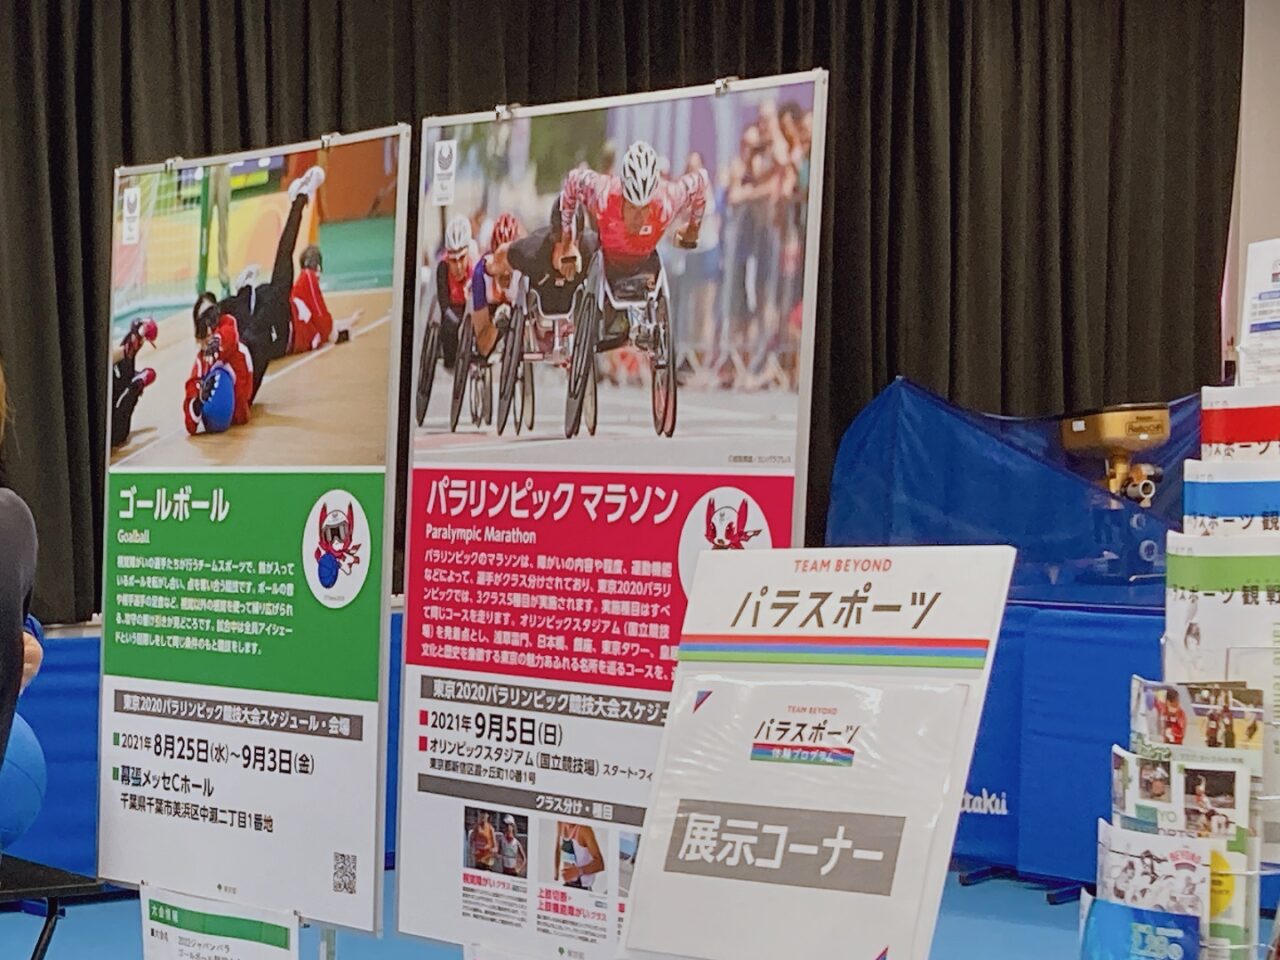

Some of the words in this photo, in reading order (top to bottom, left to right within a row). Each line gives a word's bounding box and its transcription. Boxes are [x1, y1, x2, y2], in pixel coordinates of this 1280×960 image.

[118, 485, 230, 523] ゴールボール
[427, 475, 574, 520] パラリンピック
[581, 483, 679, 524] マラソン
[117, 530, 151, 545] Goalball
[426, 524, 481, 544] Paralympic
[485, 528, 536, 544] Marathon
[794, 559, 831, 573] TEAM
[834, 558, 892, 573] BEYOND
[730, 582, 941, 630] パラスポーツ
[787, 705, 807, 714] TEAM
[809, 706, 838, 715] BEYOND
[754, 718, 861, 744] パラスポーツ
[120, 765, 214, 797] 幕張メッセCホール
[677, 813, 884, 876] 展示コーナー
